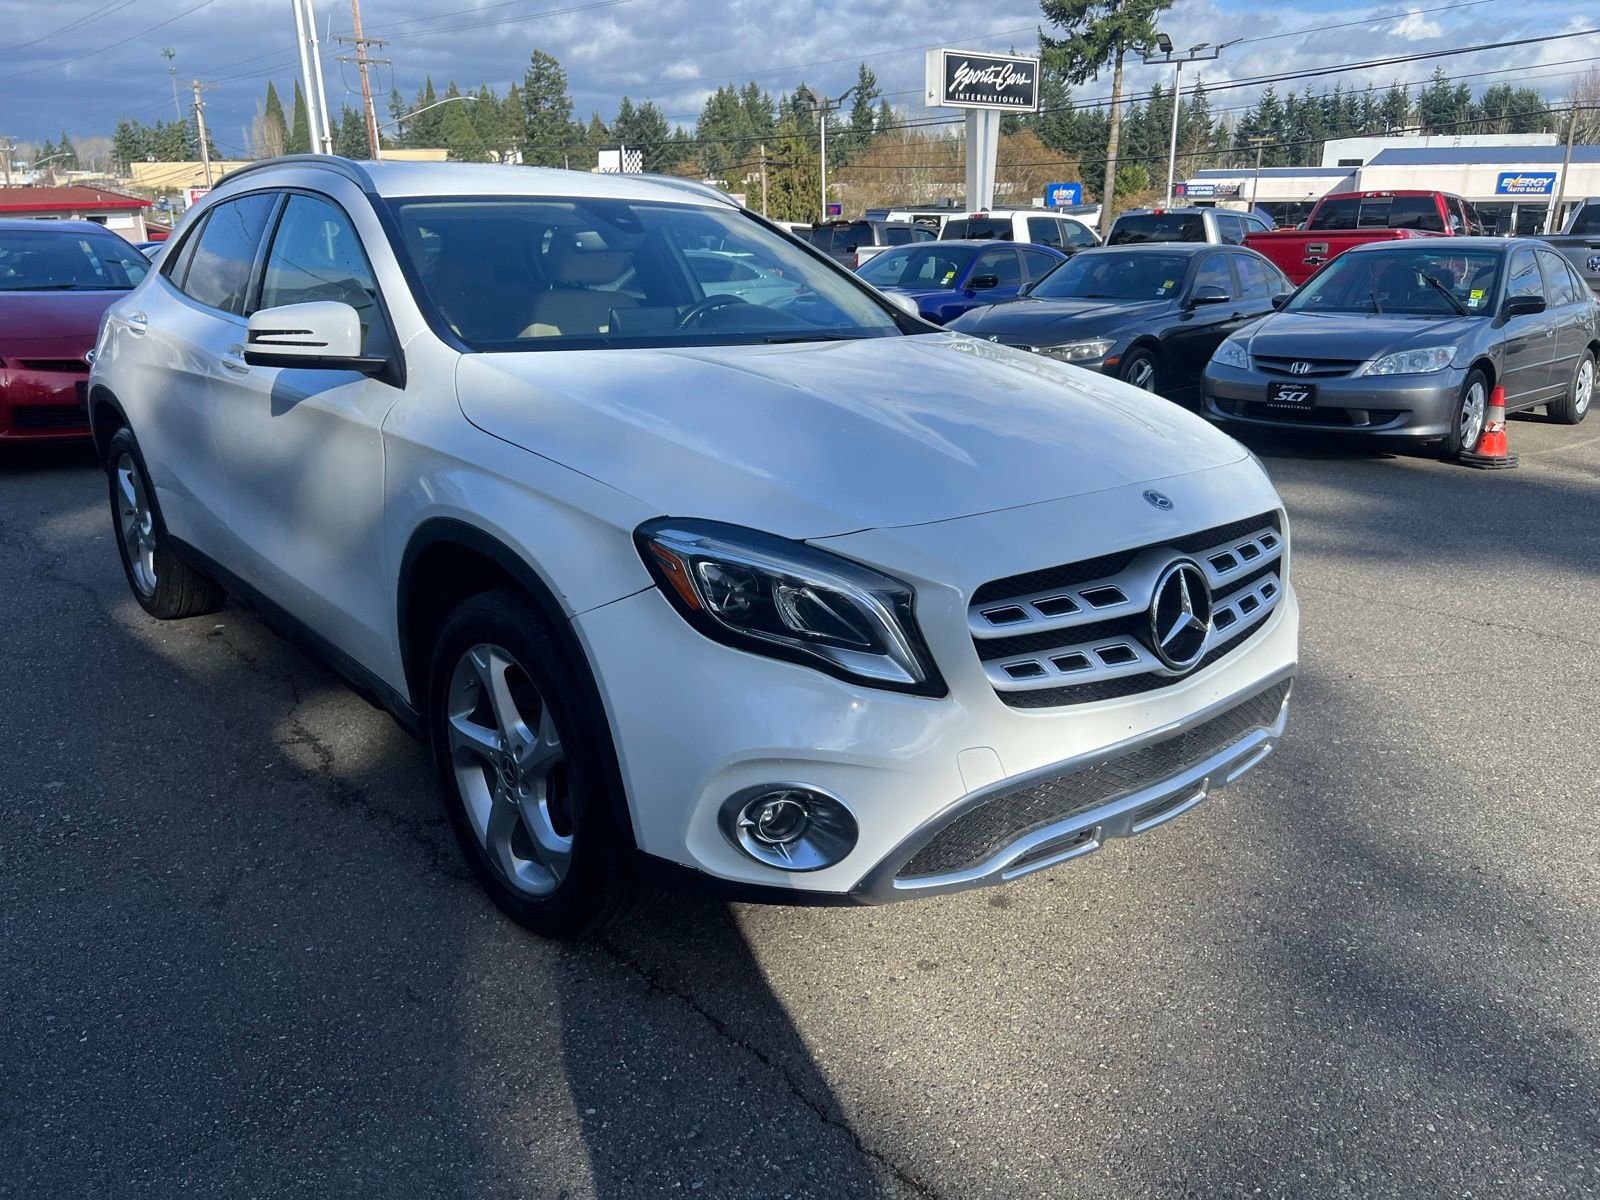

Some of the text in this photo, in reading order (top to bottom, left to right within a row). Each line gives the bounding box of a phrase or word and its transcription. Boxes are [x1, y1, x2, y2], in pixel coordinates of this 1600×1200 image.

[949, 61, 1031, 92] Sports Cars
[955, 92, 1024, 104] INTERNATIONAL
[1273, 391, 1309, 402] SCI
